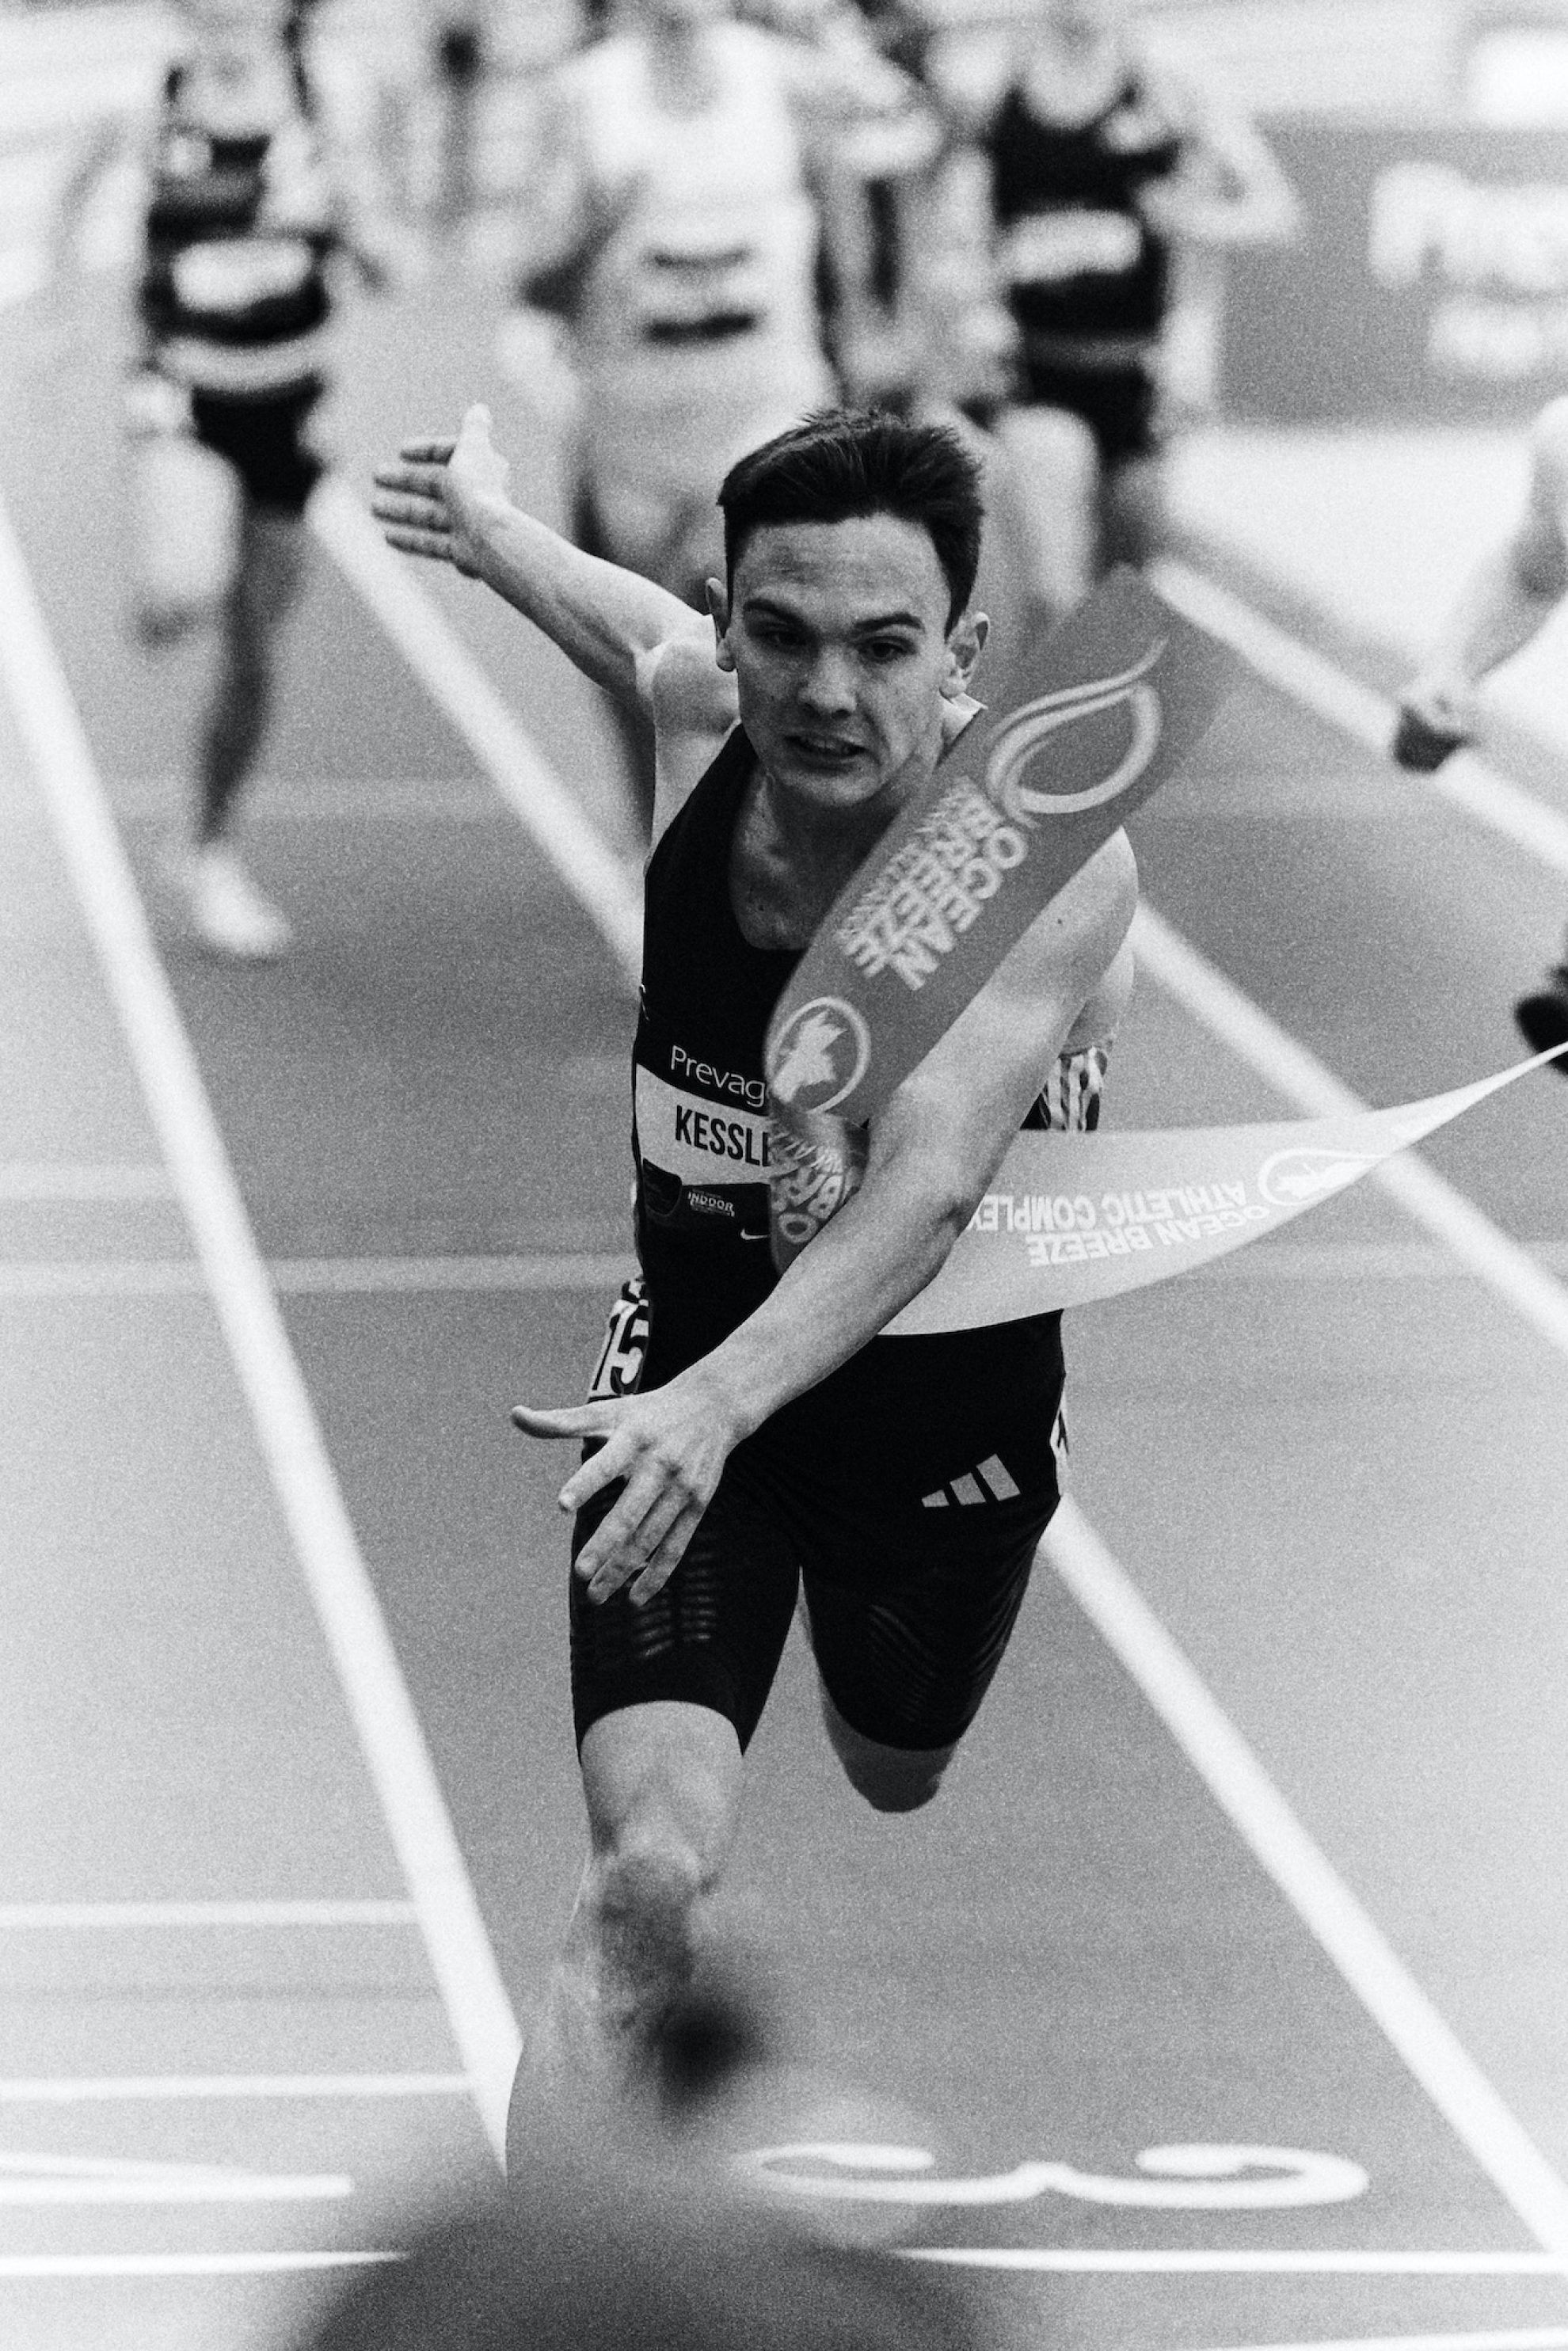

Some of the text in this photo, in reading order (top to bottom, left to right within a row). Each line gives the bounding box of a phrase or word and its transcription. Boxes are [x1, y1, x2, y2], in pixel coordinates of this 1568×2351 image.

[887, 827, 1028, 993] OCEAN
[687, 1191, 735, 1218] INDOOR
[1101, 1180, 1247, 1227] ATHLETIC
[1025, 1205, 1270, 1267] OCEAN BREEZE
